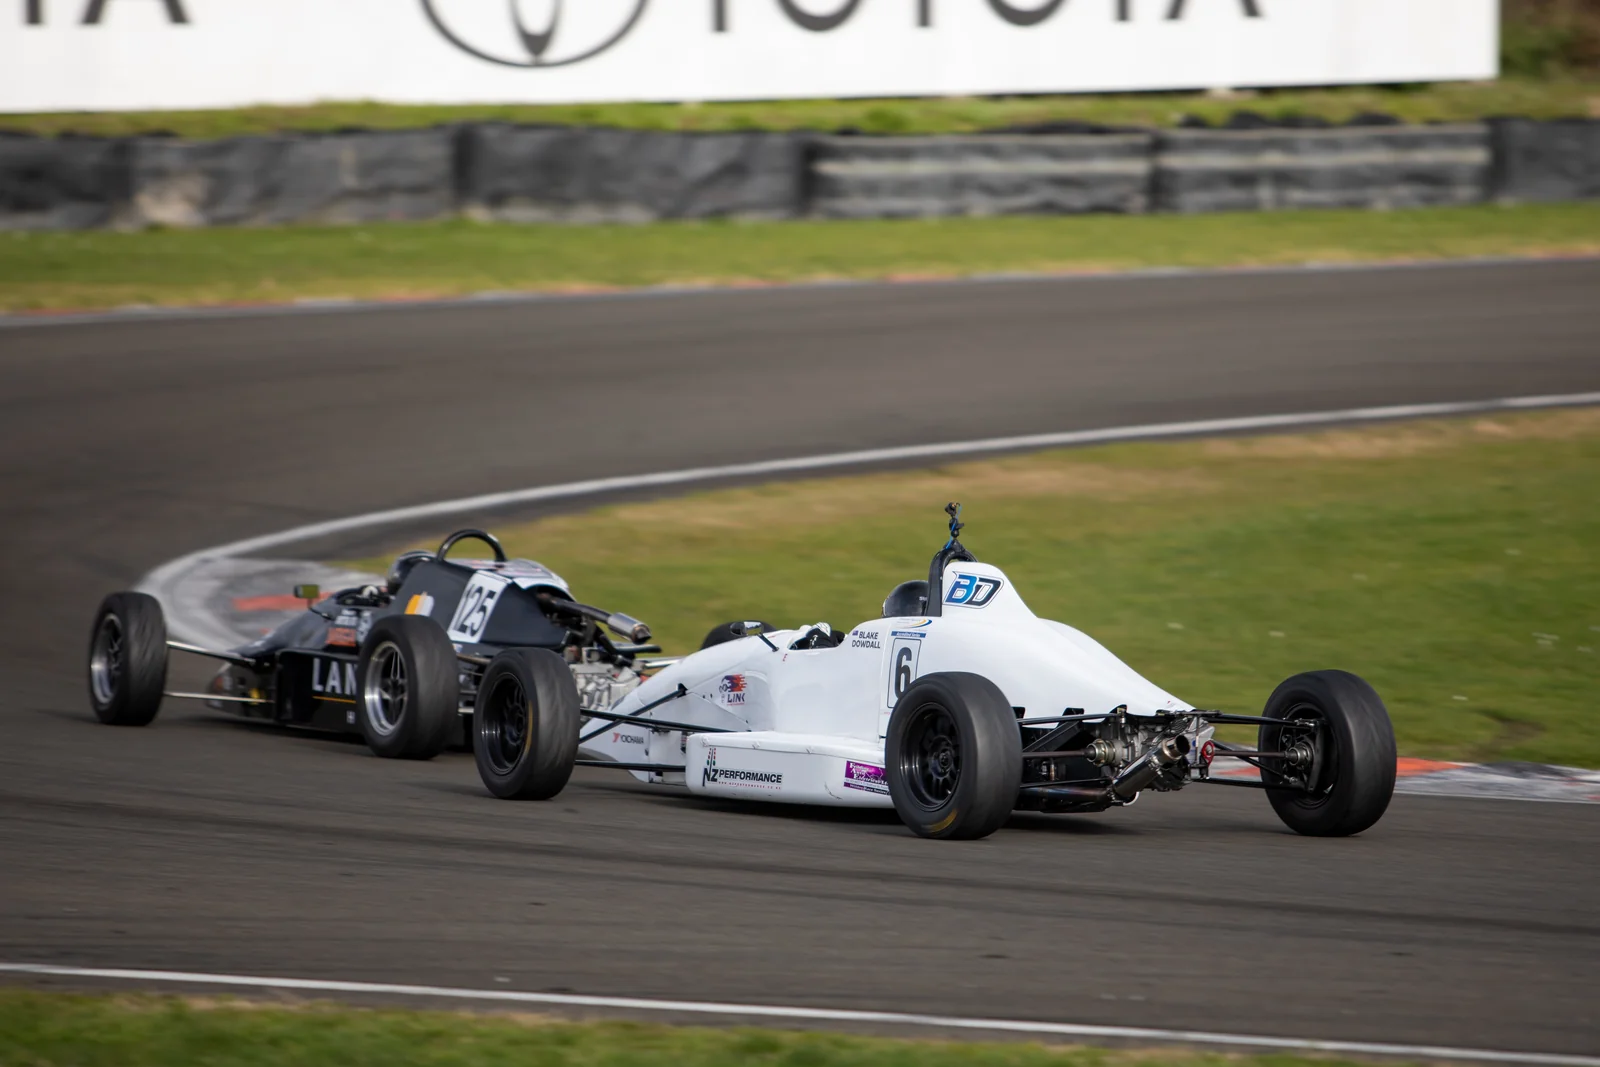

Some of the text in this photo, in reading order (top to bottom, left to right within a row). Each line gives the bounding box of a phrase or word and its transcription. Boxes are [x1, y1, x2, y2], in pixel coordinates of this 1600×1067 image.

[944, 573, 1002, 607] BD
[453, 584, 497, 637] 125
[851, 640, 881, 649] DOWDALL
[859, 631, 879, 640] BLAKE
[894, 647, 912, 700] 6
[718, 769, 783, 784] PERFORMANCE
